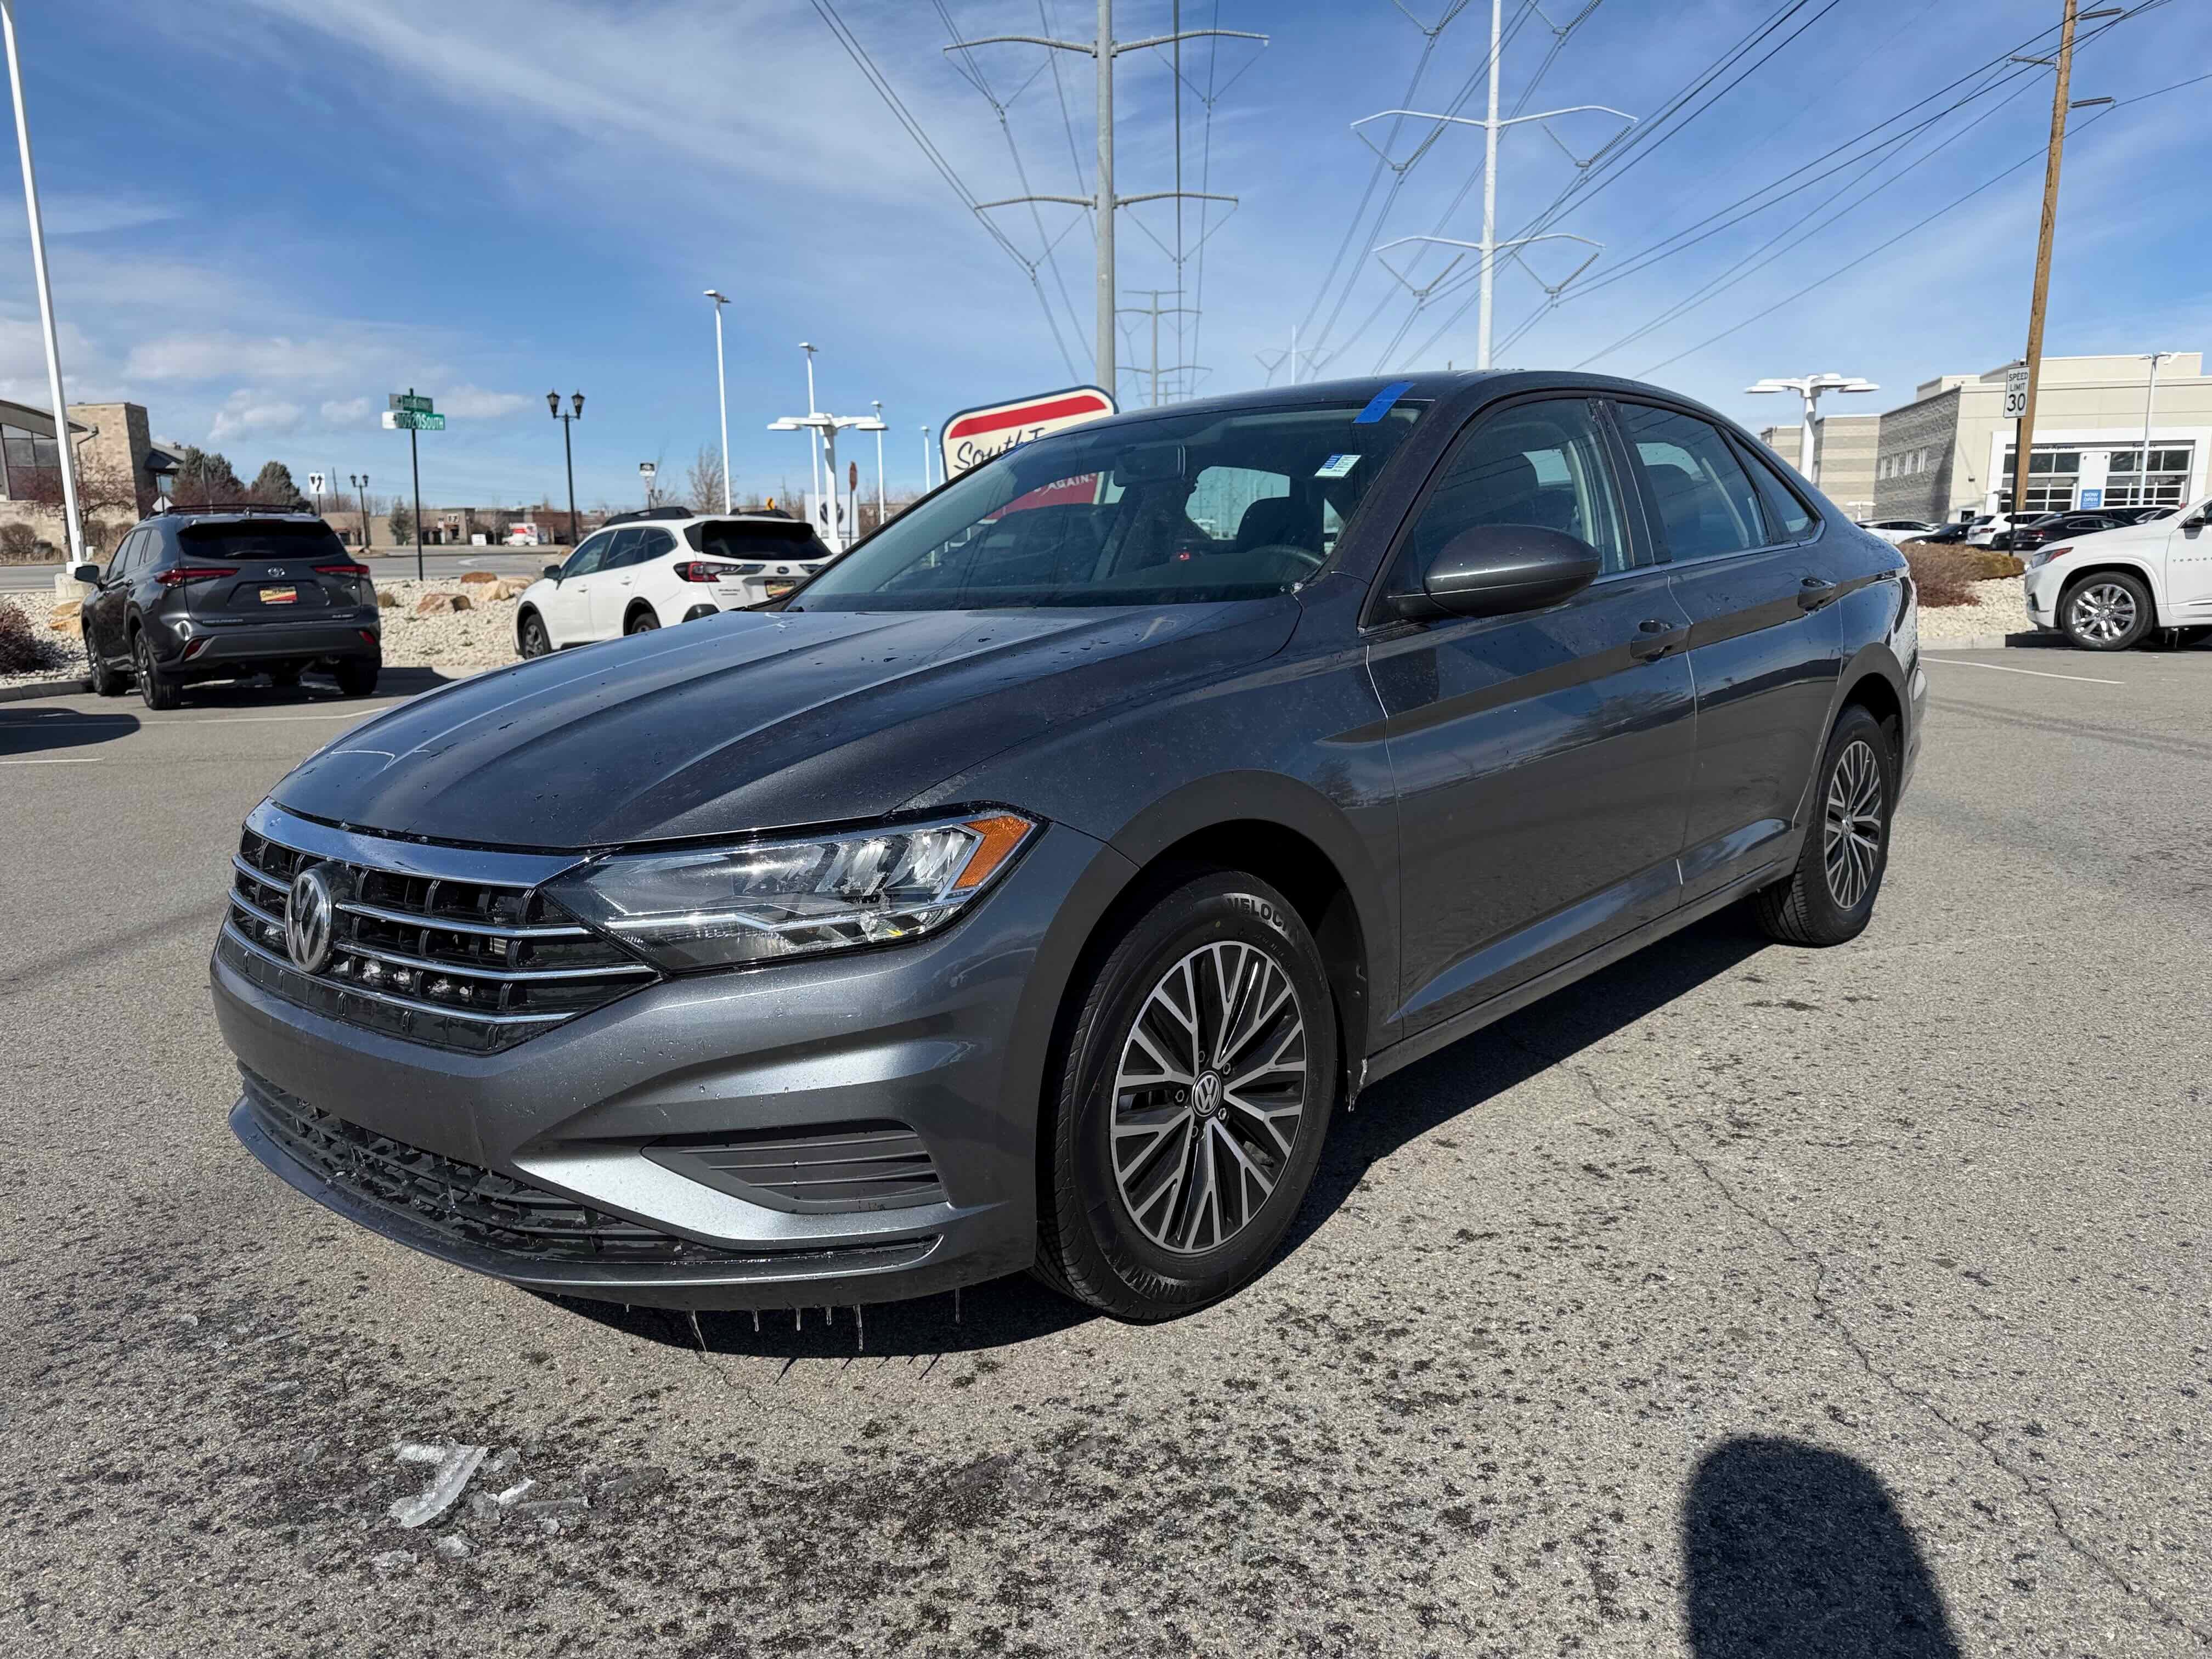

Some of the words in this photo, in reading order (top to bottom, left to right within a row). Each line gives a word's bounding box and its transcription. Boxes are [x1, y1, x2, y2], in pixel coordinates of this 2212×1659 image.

[2008, 372, 2028, 381] SPEED
[2010, 383, 2025, 391] LIMIT
[2007, 393, 2025, 411] 30
[954, 430, 1029, 470] South
